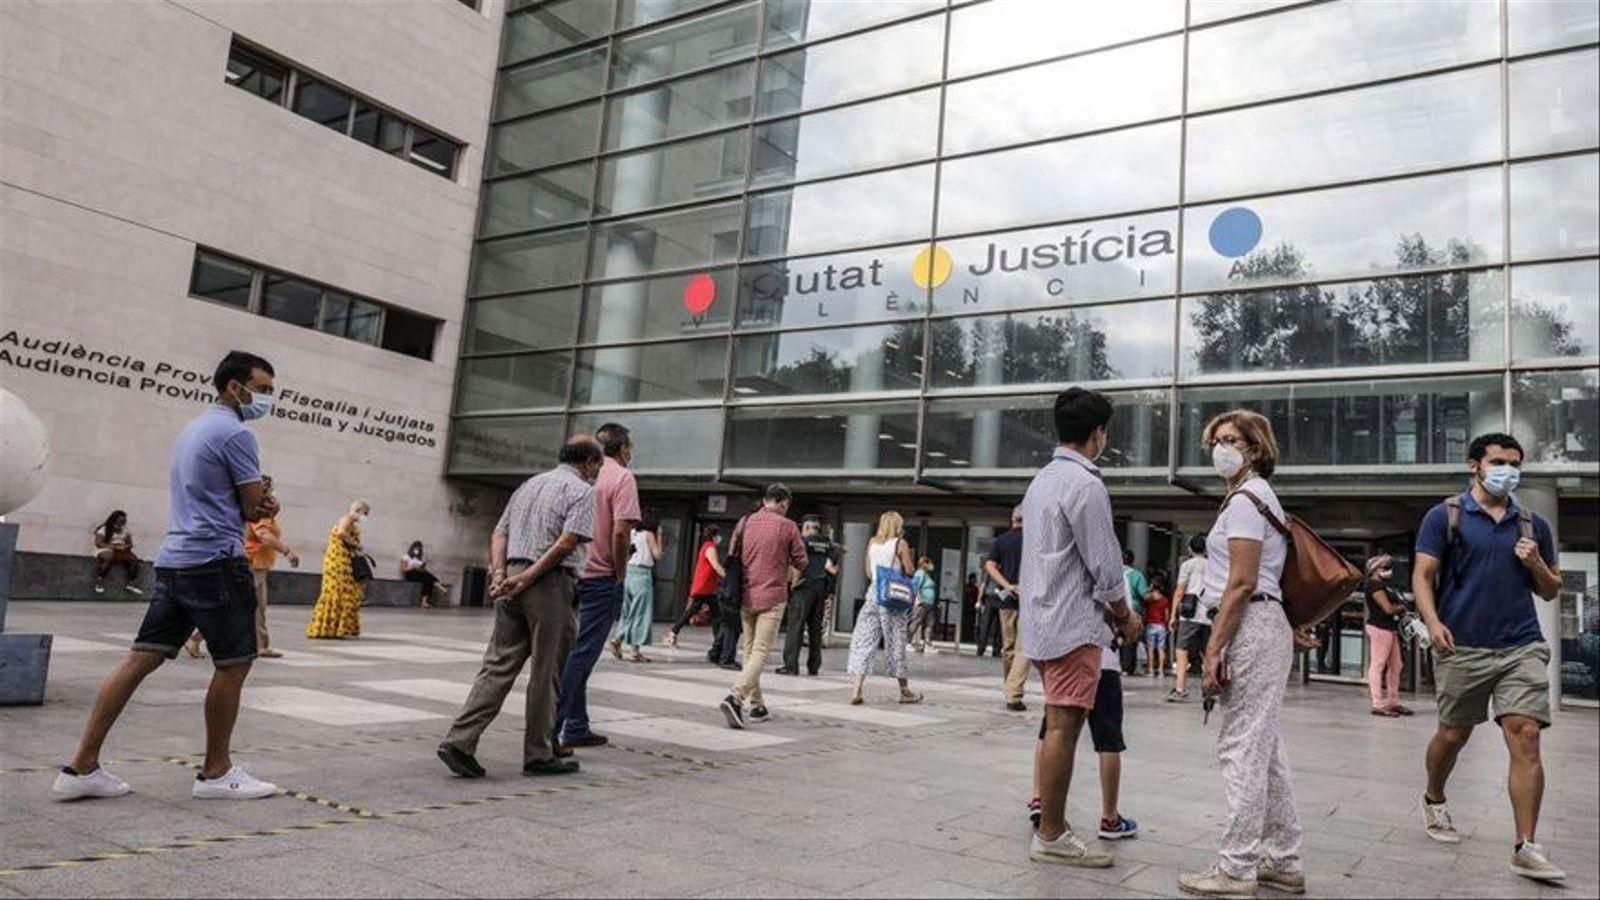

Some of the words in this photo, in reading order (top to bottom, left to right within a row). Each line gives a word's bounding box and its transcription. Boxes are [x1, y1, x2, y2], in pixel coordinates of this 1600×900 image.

[968, 225, 1175, 276] Justícia
[0, 331, 146, 374] Audiència
[154, 362, 215, 386] Prov
[373, 410, 435, 433] Jutjats
[0, 350, 131, 389] Audiencia
[140, 376, 220, 404] Provin
[338, 420, 349, 433] y
[353, 422, 436, 449] Juzgados
